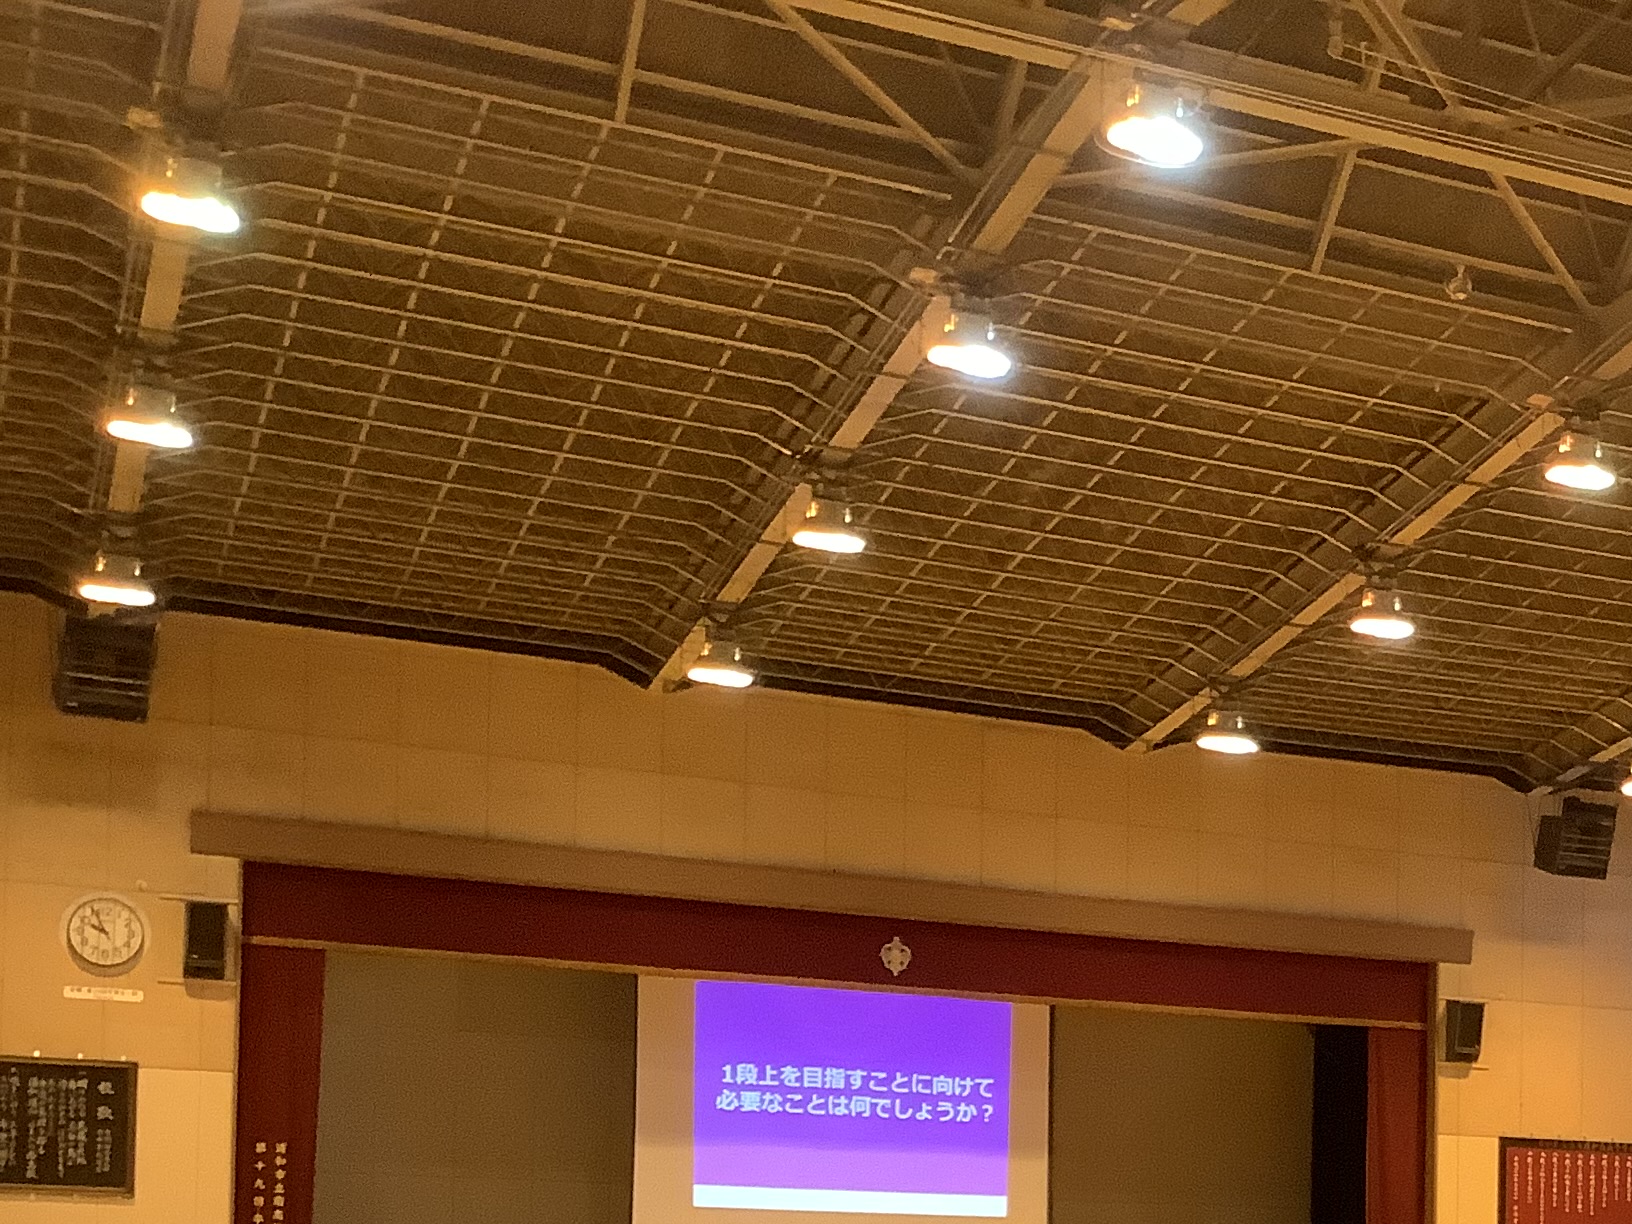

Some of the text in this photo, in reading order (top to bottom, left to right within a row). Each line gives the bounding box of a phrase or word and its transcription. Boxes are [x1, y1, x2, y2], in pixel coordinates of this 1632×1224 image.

[721, 1063, 994, 1098] 1段上を目指すことに向けて
[715, 1088, 993, 1122] 必要なことは何でしょうか？
